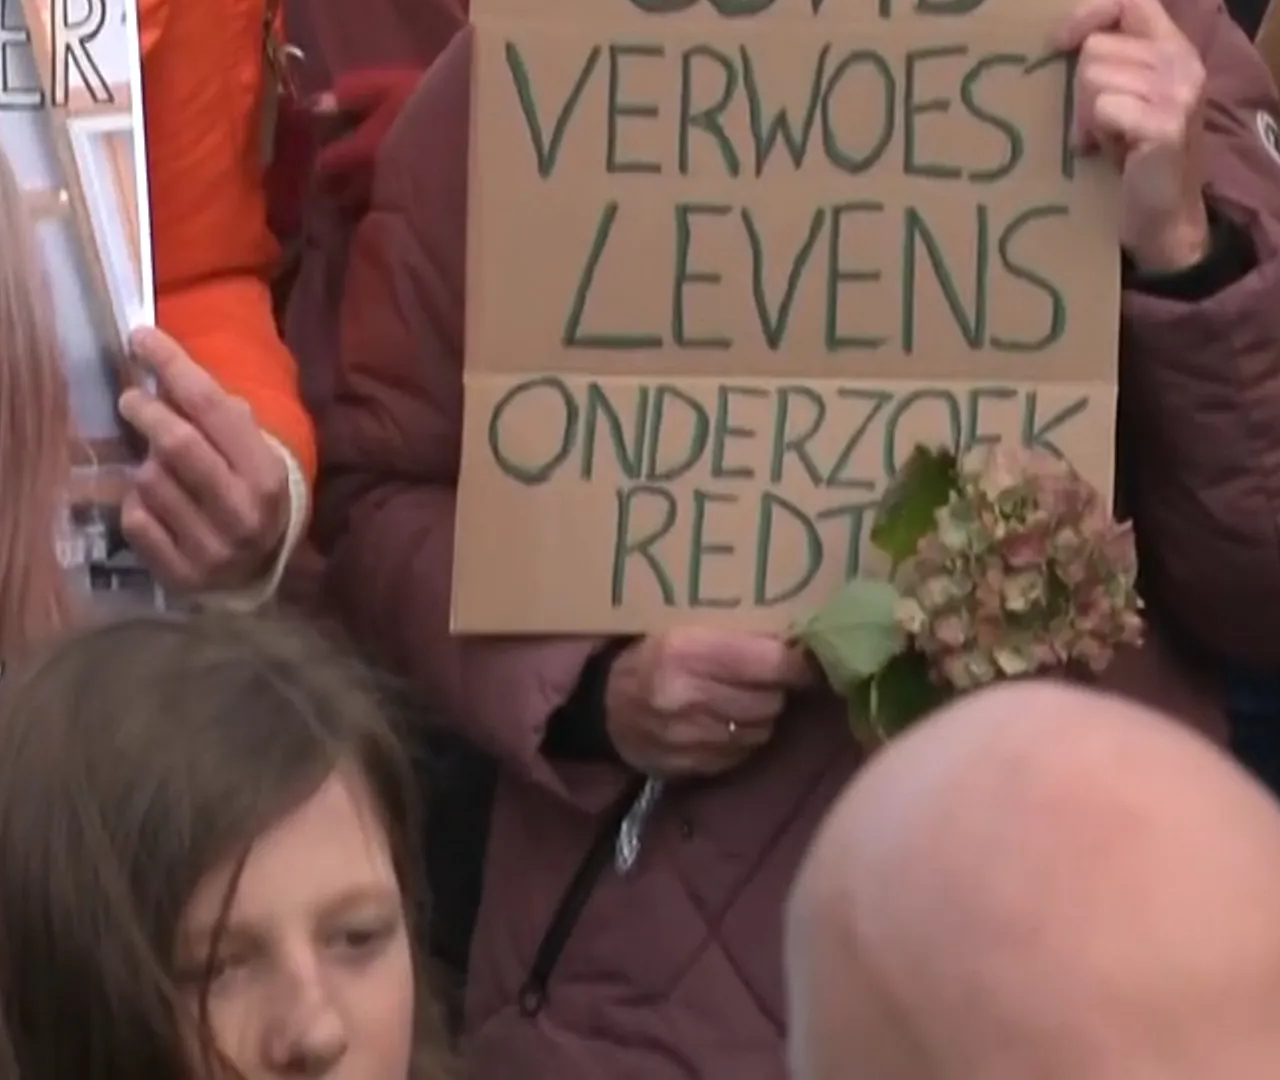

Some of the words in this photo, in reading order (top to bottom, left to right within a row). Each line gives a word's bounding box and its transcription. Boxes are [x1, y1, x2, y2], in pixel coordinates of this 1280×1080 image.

[505, 41, 1078, 181] VERWOEST
[562, 200, 1070, 354] LEVENS
[488, 375, 1090, 490] ONDERZOEK
[610, 485, 885, 610] REDT
